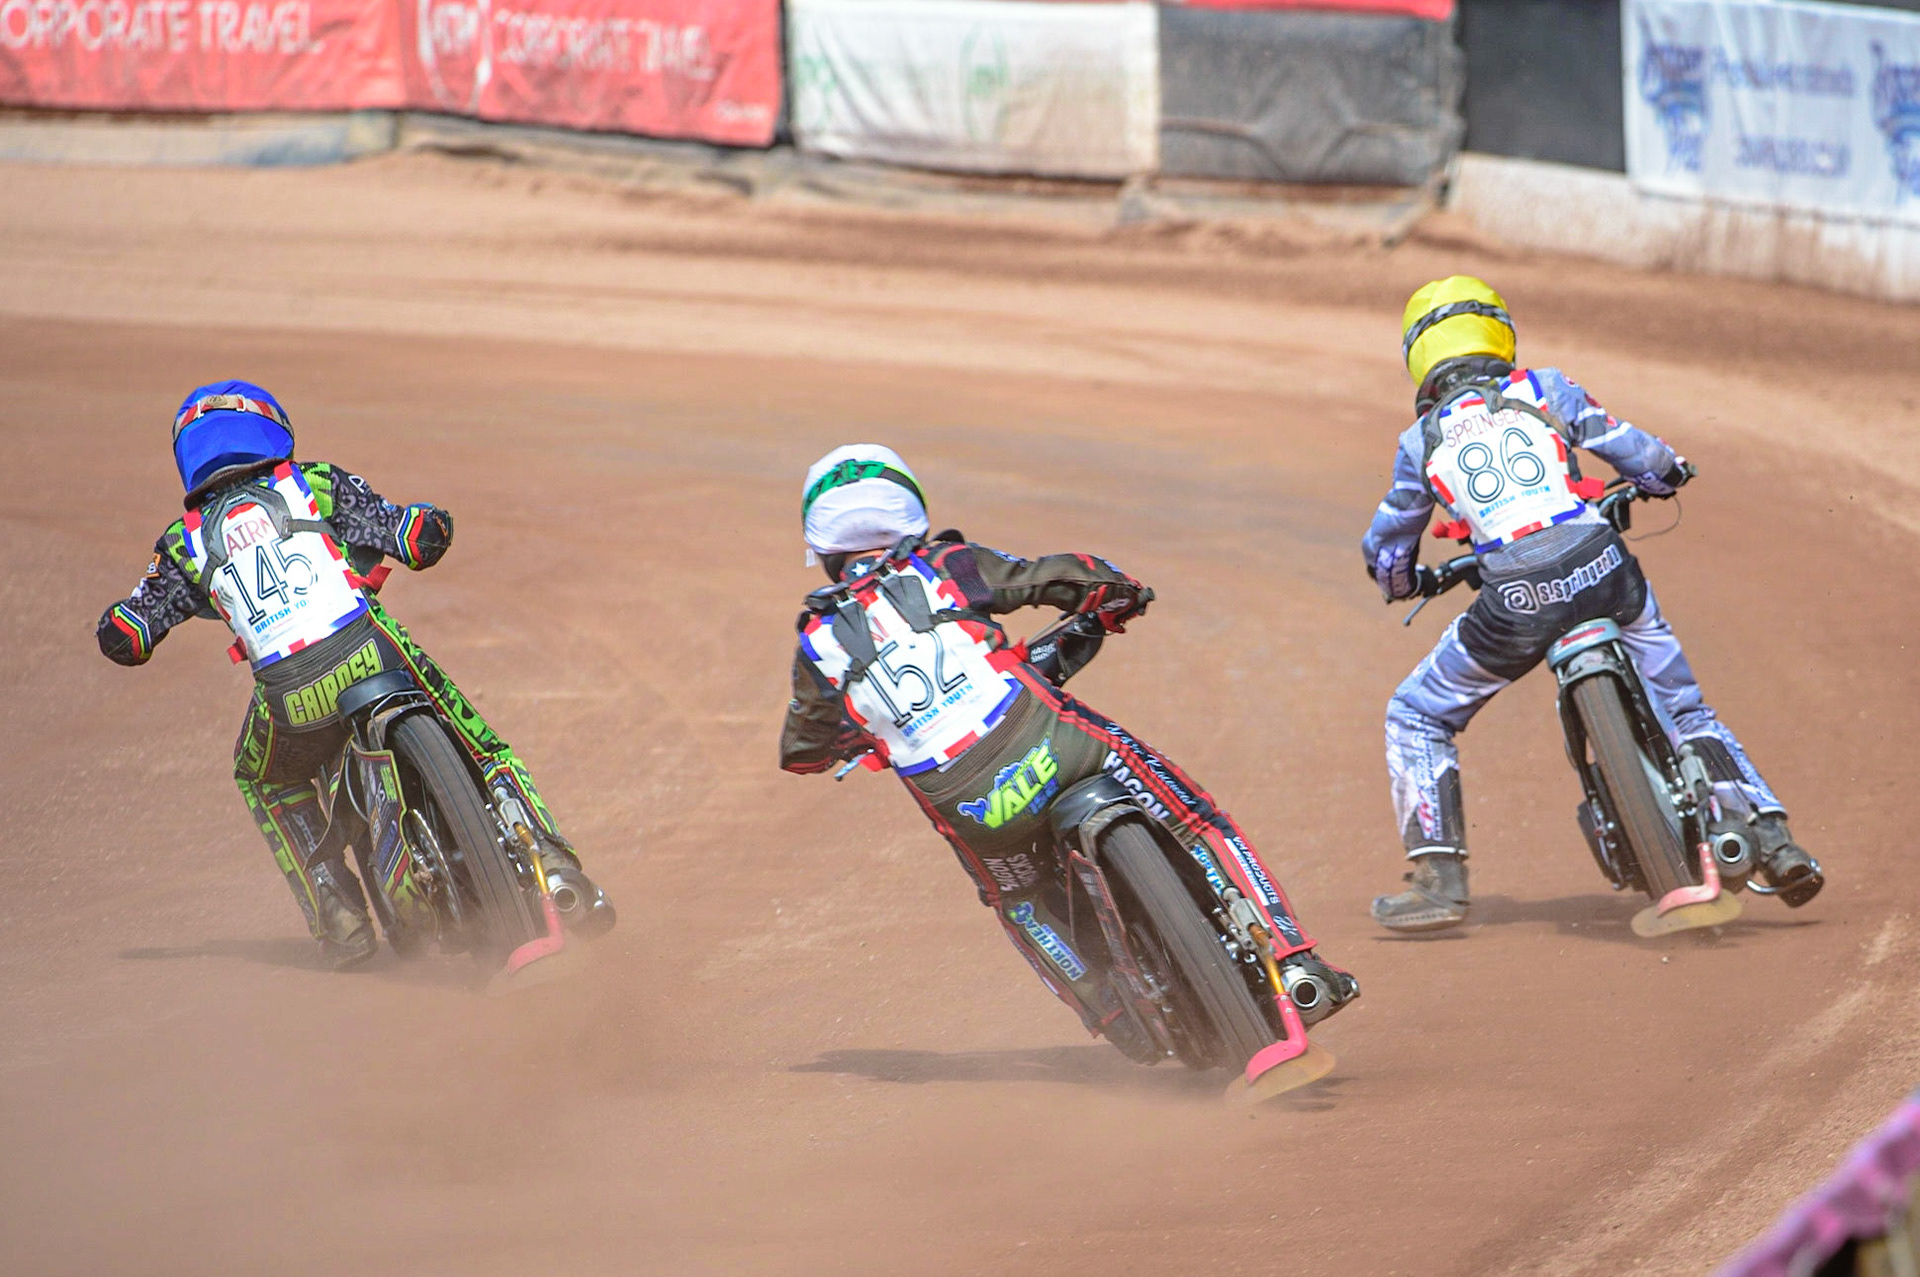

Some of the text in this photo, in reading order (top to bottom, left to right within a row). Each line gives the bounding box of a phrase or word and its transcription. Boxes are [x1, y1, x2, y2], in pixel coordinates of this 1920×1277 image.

[200, 0, 325, 54] TRAVEL
[1445, 409, 1525, 448] SPRINGER
[1457, 426, 1546, 504] 86
[1478, 495, 1516, 518] BRITISH
[222, 537, 319, 626] 145
[254, 607, 292, 634] BRITISH
[864, 628, 968, 729] 152
[901, 707, 940, 738] BRITISH
[940, 683, 974, 708] YOUTH
[981, 742, 1059, 830] VALE
